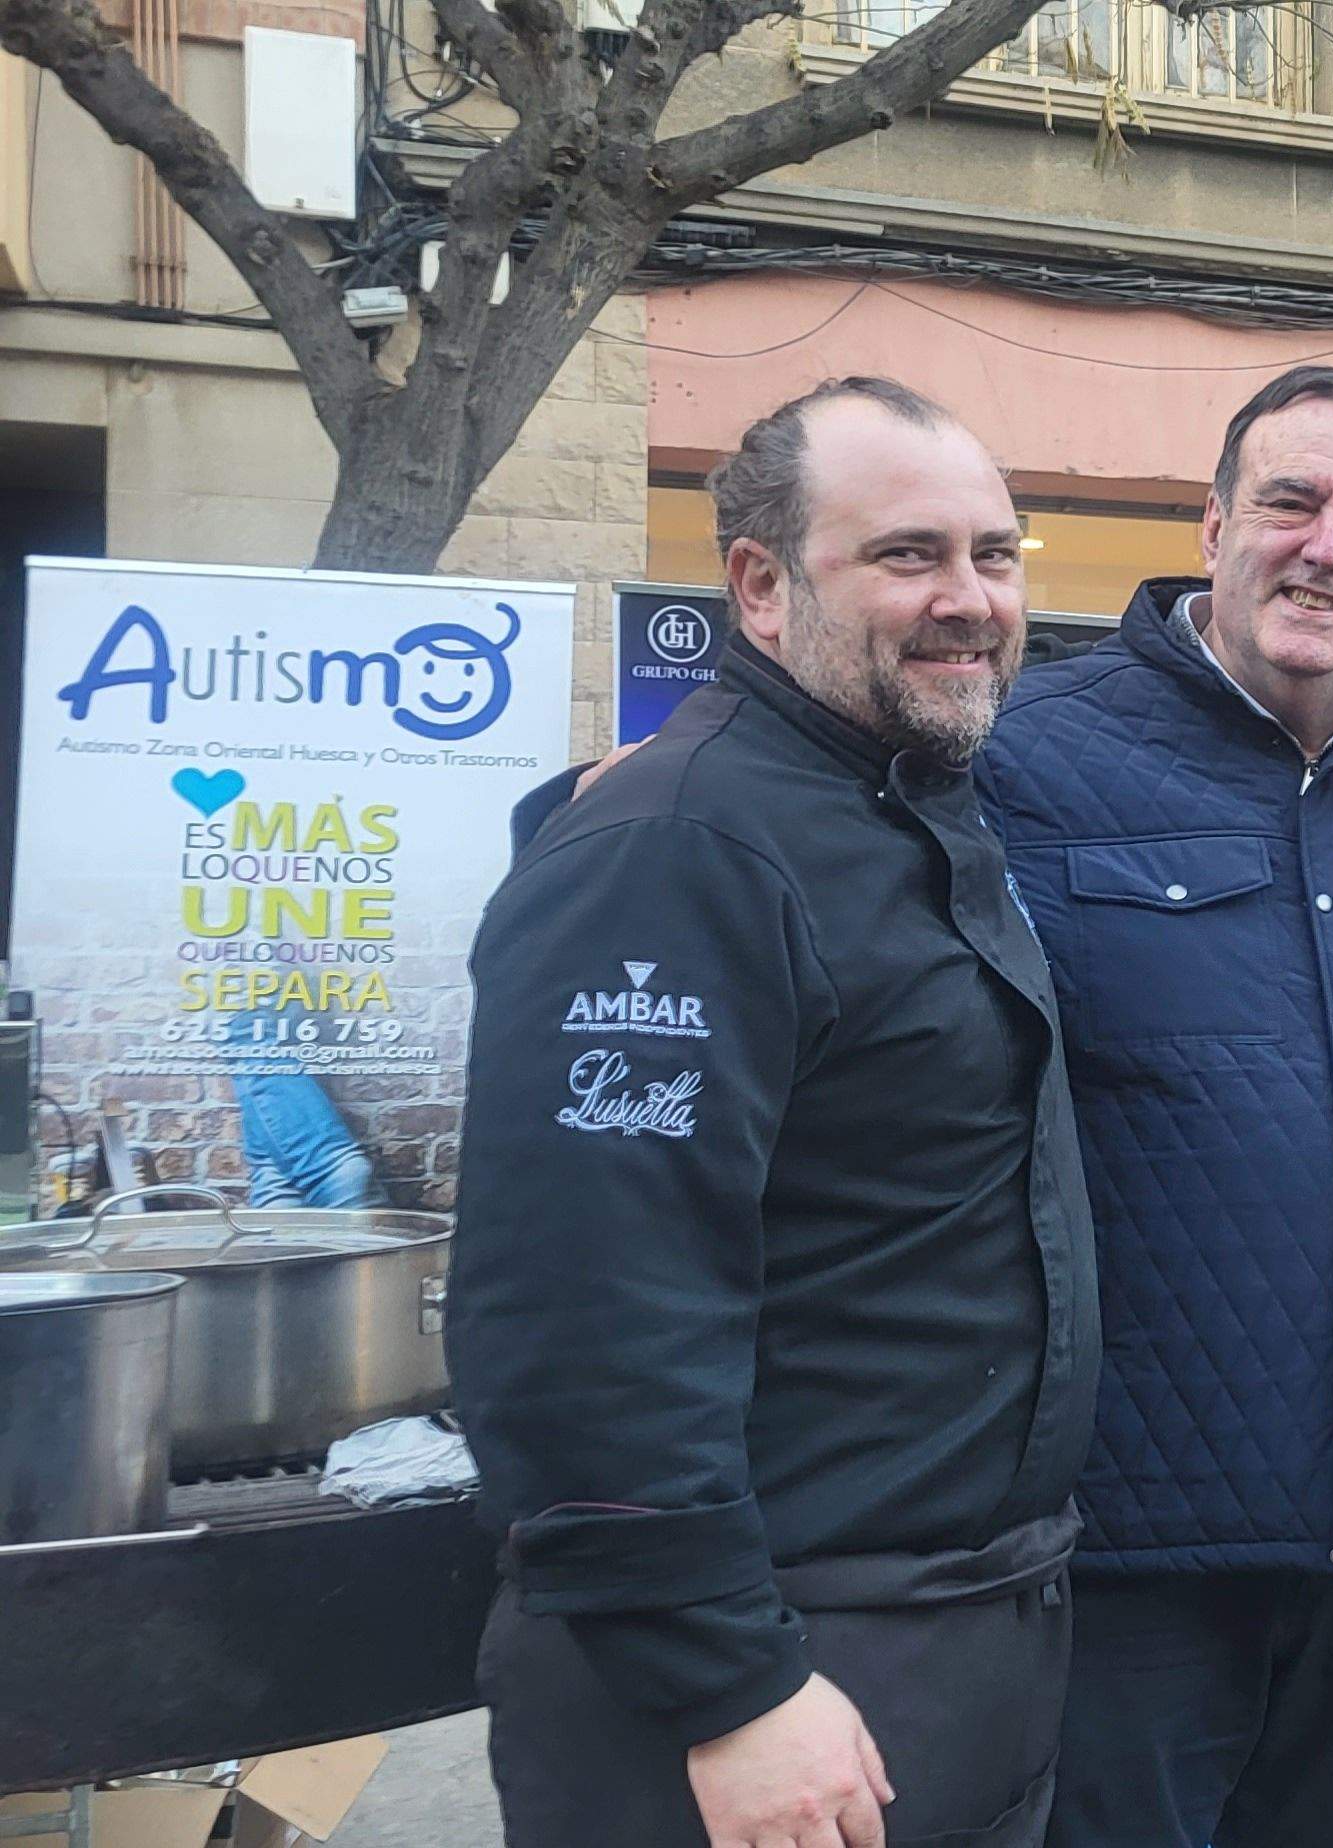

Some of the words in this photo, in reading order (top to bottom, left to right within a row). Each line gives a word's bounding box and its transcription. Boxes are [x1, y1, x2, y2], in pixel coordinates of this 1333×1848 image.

[57, 603, 521, 742] Autismo
[632, 665, 690, 680] GRUPO
[57, 736, 142, 756] Autismo
[146, 738, 198, 757] Zona
[204, 741, 284, 760] Oriental
[289, 743, 359, 762] Huesca
[364, 751, 376, 767] y
[381, 747, 437, 766] Otros
[440, 749, 538, 769] Trastornos
[185, 822, 226, 850] ES
[230, 793, 399, 855] MÁS
[181, 853, 393, 884] LOQUENOS
[180, 885, 396, 941] UNE
[177, 941, 396, 964] QUELOQUENOS
[178, 968, 394, 1012] SEPARA
[565, 990, 707, 1028] AMBAR
[160, 1018, 231, 1043] 625
[252, 1018, 321, 1043] 116
[334, 1018, 404, 1043] 759
